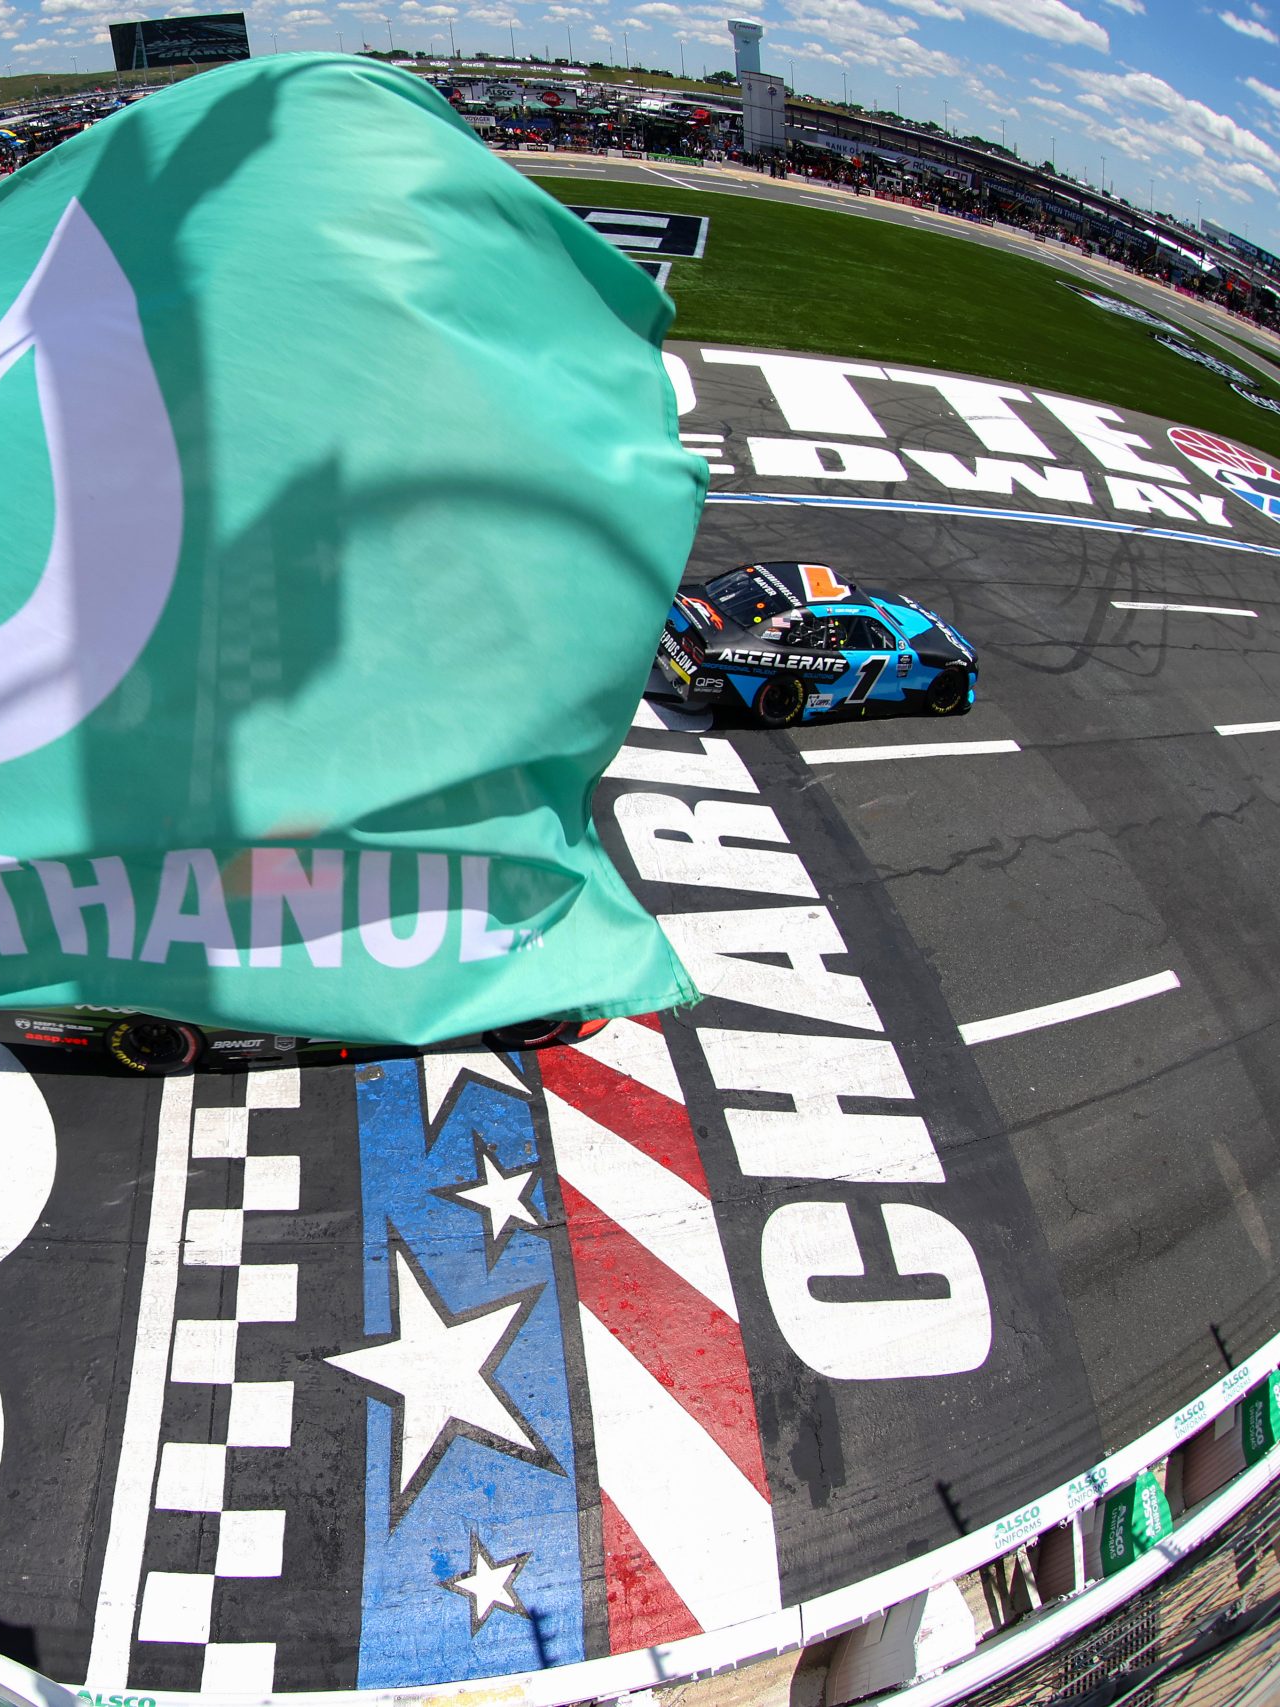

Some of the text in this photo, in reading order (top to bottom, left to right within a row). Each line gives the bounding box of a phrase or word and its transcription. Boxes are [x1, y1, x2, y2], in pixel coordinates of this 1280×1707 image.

[485, 88, 515, 97] ALSCO
[826, 141, 847, 153] BANK
[1045, 202, 1063, 215] THEN
[753, 576, 777, 597] MAYER
[718, 648, 847, 673] ACCELERATE
[695, 676, 724, 689] QPS
[844, 654, 891, 705] 1
[24, 1032, 89, 1046] aasp.vet
[210, 1038, 265, 1050] BRANDT
[600, 698, 993, 1381] CHARL
[1221, 1366, 1250, 1395] ALSCO
[1222, 1376, 1252, 1402] UNIFORMS
[1173, 1400, 1206, 1431] ALSCO
[1174, 1411, 1208, 1440] UNIFORMS
[1254, 1401, 1265, 1446] ALSCO
[1067, 1467, 1108, 1499] ALSCO
[1067, 1479, 1110, 1510] UNIFORMS
[993, 1505, 1041, 1540] ALSCO
[1142, 1488, 1156, 1539] ALSCO
[1149, 1484, 1162, 1534] UNIFORMS
[994, 1519, 1042, 1550] UNIFORMS
[1109, 1507, 1119, 1560] UNIFORMS
[1114, 1503, 1127, 1558] ALSCO
[76, 1690, 157, 1707] ALSCO
